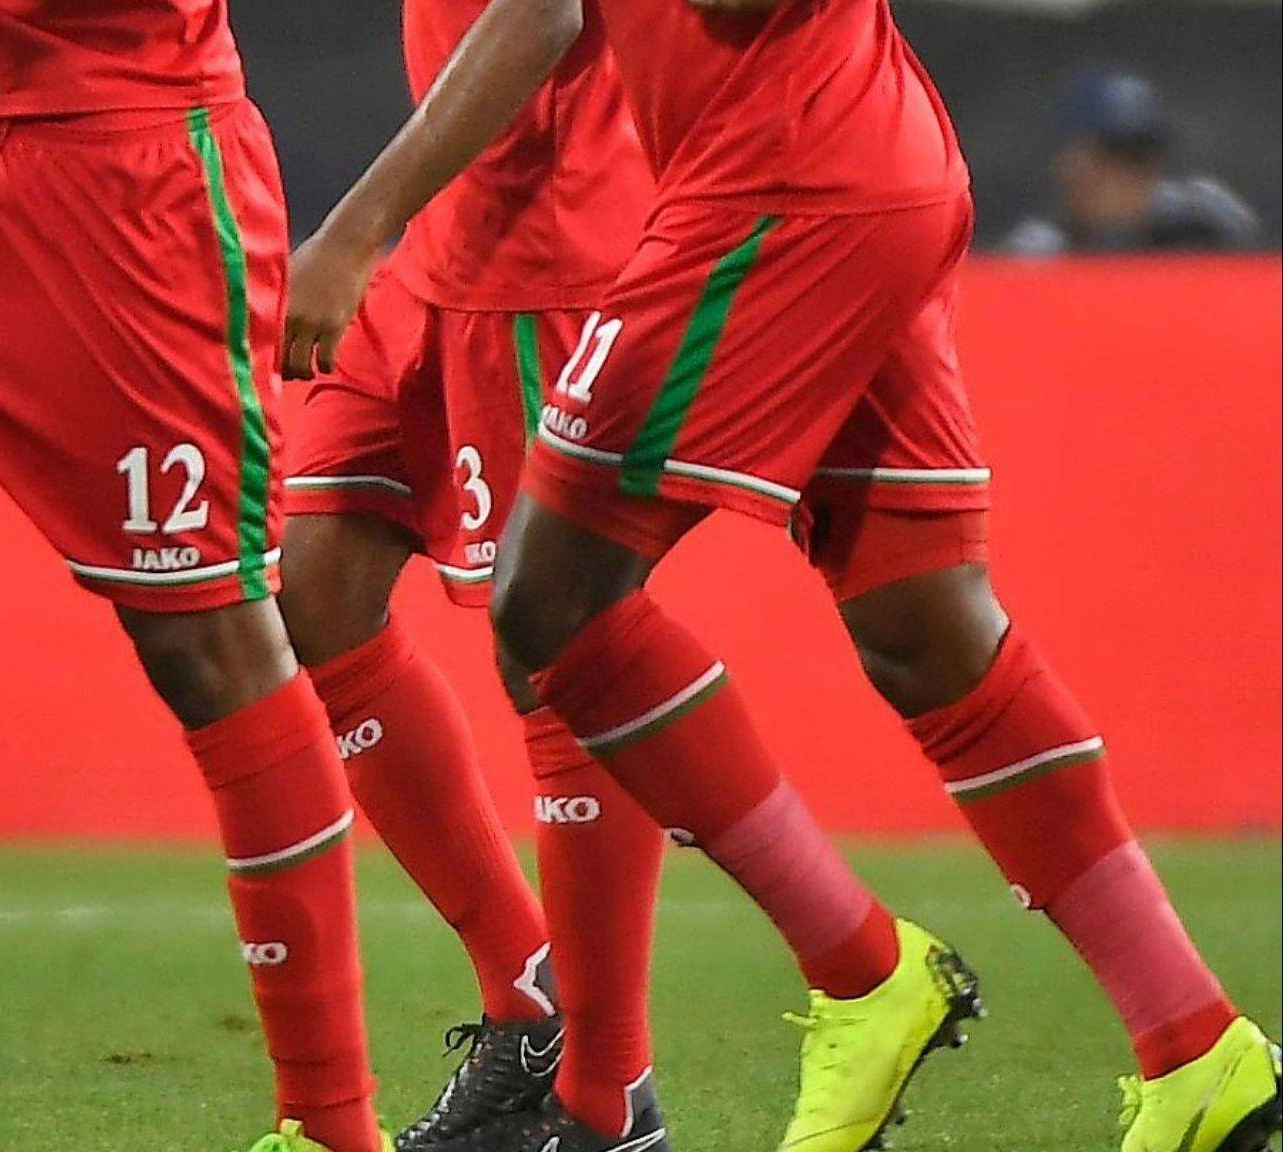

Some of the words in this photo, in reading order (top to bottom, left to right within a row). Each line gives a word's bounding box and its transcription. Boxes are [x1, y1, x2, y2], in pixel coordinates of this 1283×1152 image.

[555, 310, 623, 406] 11
[116, 443, 209, 534] 12
[133, 546, 201, 570] JAKO
